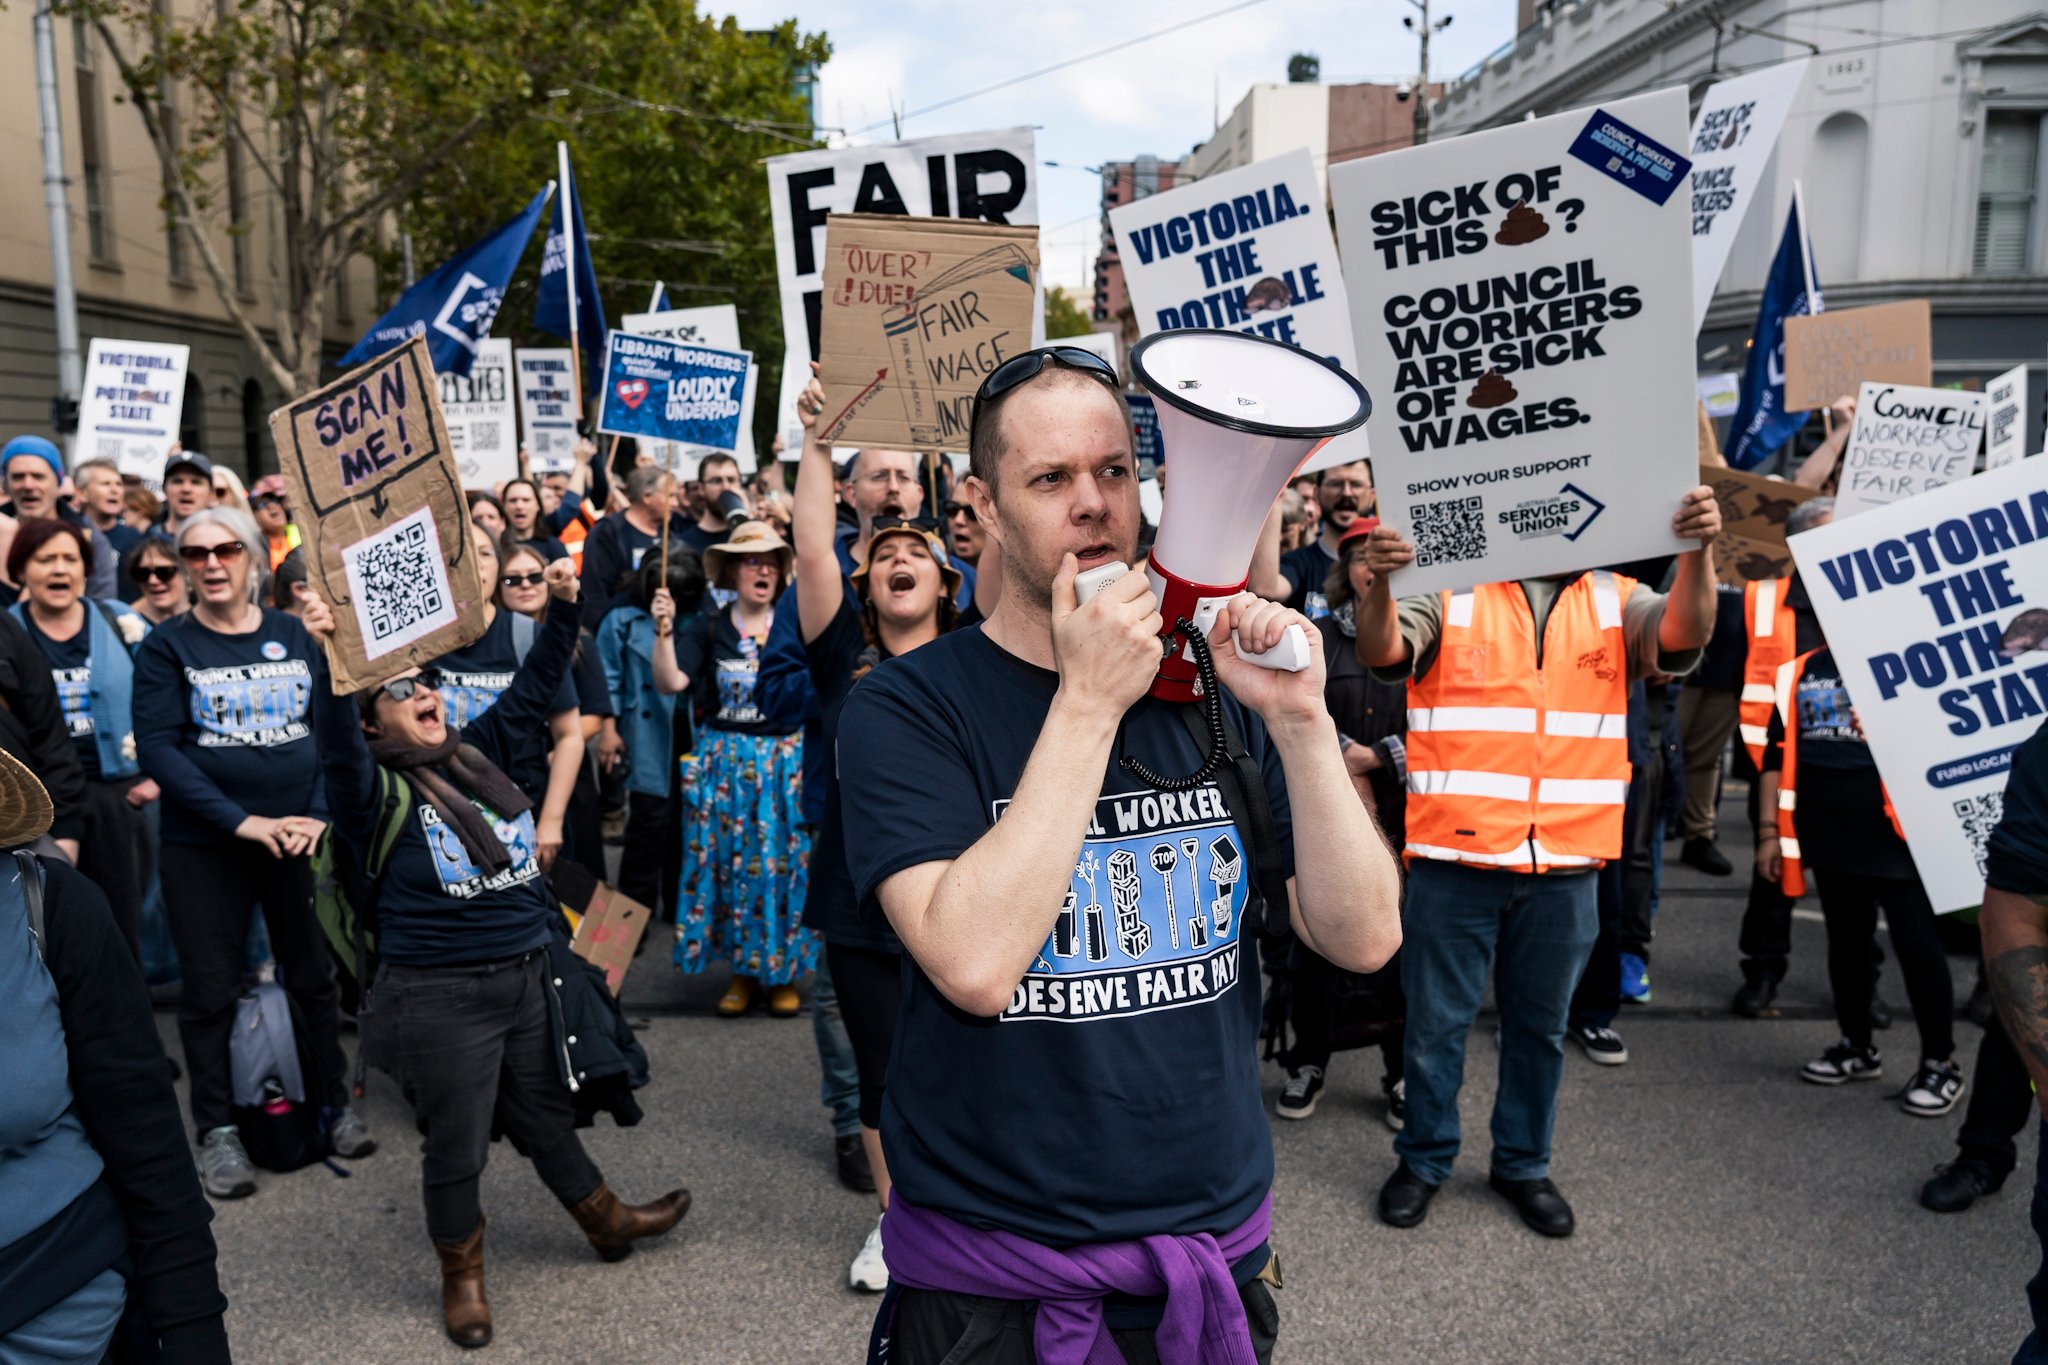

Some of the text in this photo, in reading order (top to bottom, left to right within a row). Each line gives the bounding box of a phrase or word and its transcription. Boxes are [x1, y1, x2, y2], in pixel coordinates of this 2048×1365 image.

[1601, 123, 1636, 149] COUNCIL
[787, 150, 1026, 276] FAIR
[1370, 165, 1562, 236] SICK OF
[1129, 182, 1310, 265] VICTORIA.
[1373, 198, 1585, 270] THIS ?
[848, 247, 917, 279] OVER
[1195, 238, 1263, 289] THE
[1384, 258, 1606, 327] COUNCIL
[919, 291, 990, 341] FAIR
[1385, 286, 1642, 360] WORKERS
[613, 337, 673, 362] LIBRARY
[1394, 325, 1607, 393] ARE SICK
[315, 361, 407, 448] SCAN
[667, 375, 737, 402] LOUDLY
[1397, 386, 1456, 422] OF
[1874, 388, 1984, 430] COUNCIL
[109, 405, 153, 421] STATE
[665, 400, 739, 421] UNDERPAID
[1399, 397, 1591, 453] WAGES.
[1857, 418, 1970, 453] WORKERS
[1407, 454, 1592, 495] SHOW YOUR SUPPORT
[1850, 447, 1966, 476] DESERVE
[1852, 472, 1914, 497] FAIR
[1498, 500, 1580, 524] SERVICES
[1512, 515, 1568, 534] UNION
[1919, 560, 2024, 627] THE
[188, 661, 308, 686] COUNCIL WORKERS
[1936, 763, 1973, 782] FUND
[1114, 788, 1231, 833] WORKER
[1152, 850, 1175, 866] STOP
[1007, 949, 1237, 1015] DESERVE FAIR PAY
